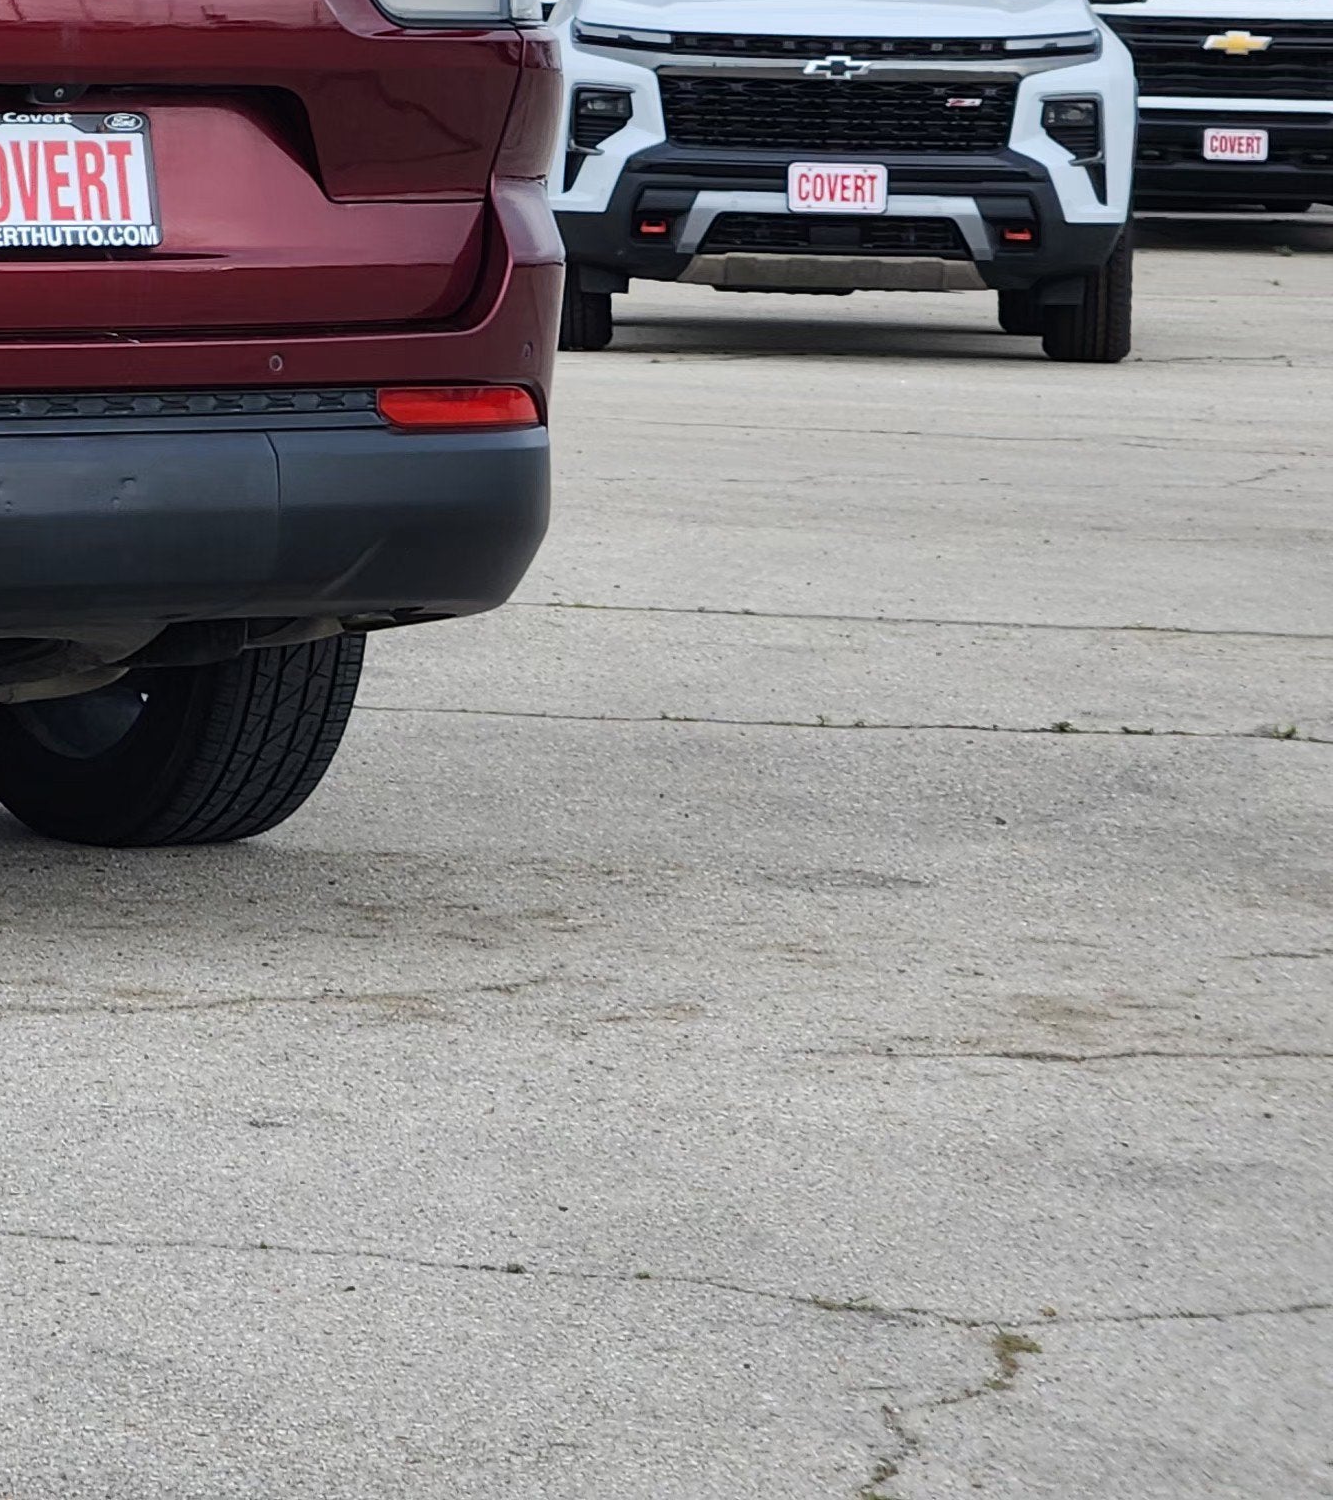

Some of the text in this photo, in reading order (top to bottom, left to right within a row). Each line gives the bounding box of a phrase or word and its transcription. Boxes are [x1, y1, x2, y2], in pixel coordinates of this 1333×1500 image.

[2, 112, 73, 124] Covert
[1210, 134, 1262, 155] COVERT
[797, 172, 878, 204] COVERT
